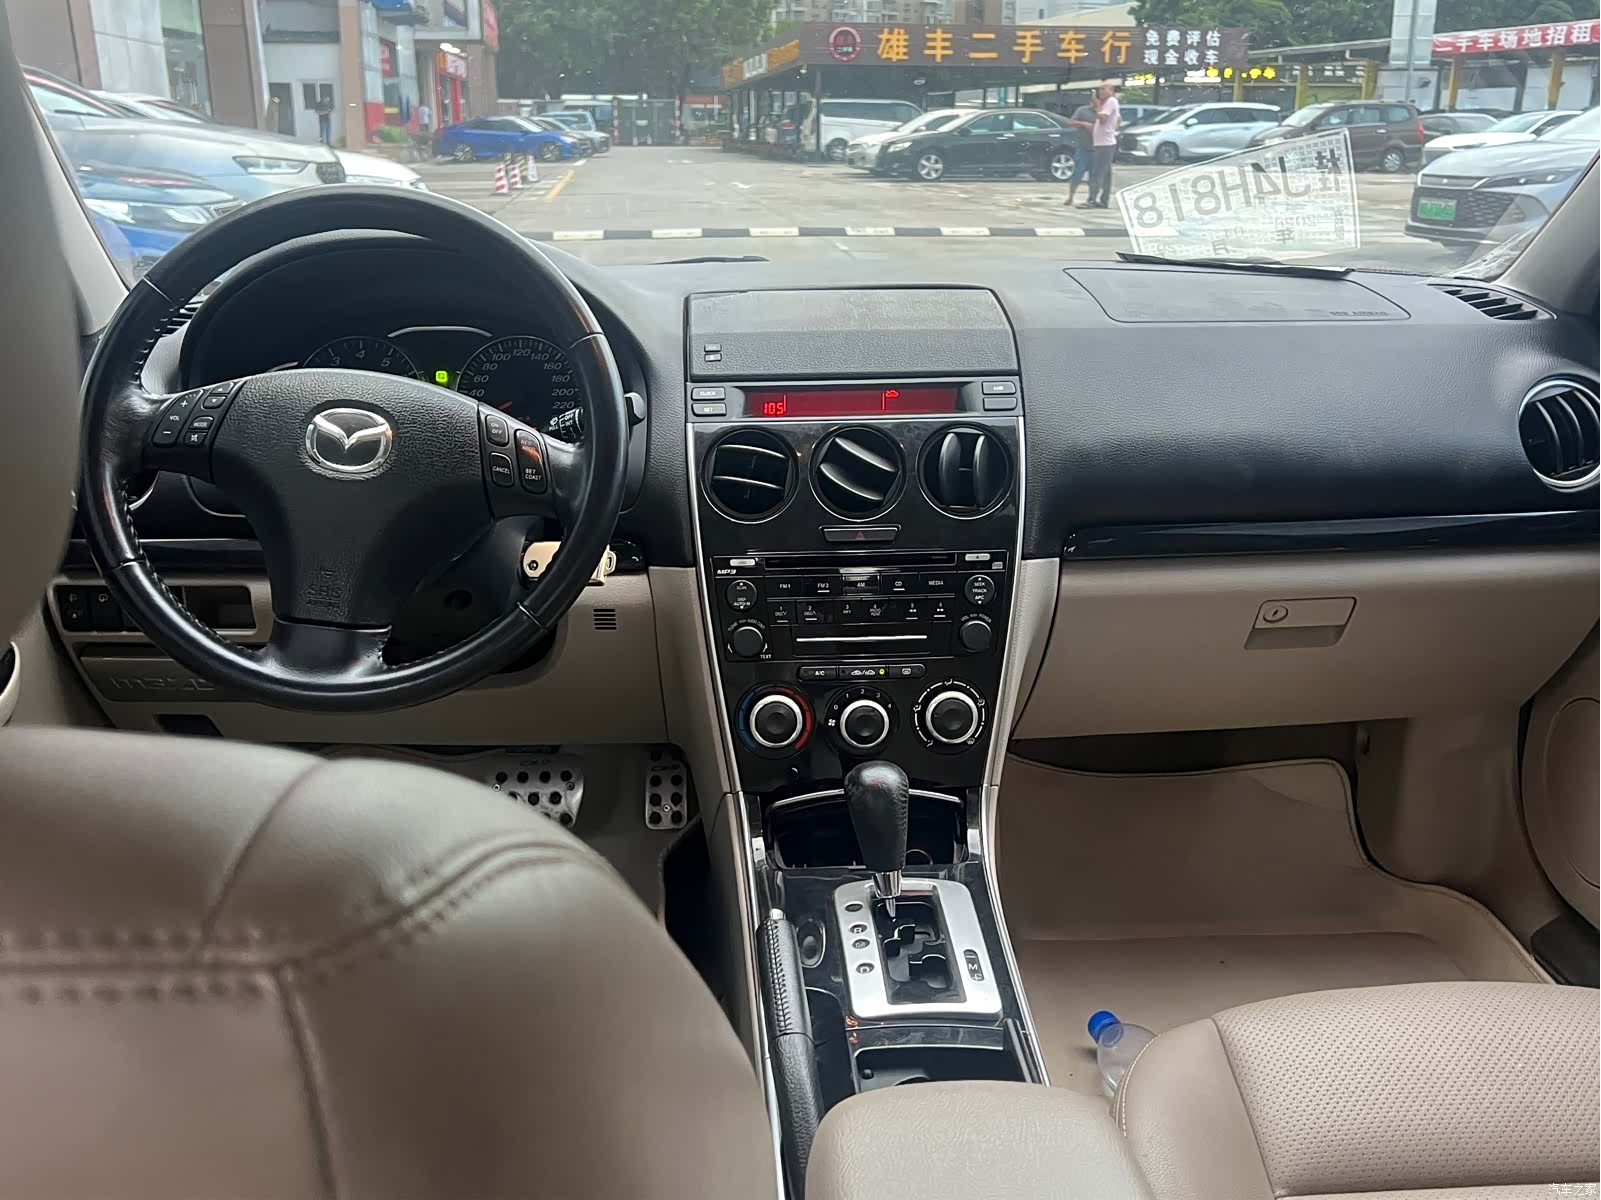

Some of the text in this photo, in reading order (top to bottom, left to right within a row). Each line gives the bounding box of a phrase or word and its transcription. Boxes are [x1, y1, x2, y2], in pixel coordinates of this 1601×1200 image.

[1144, 29, 1222, 48] 免费评估
[1432, 24, 1592, 53] 二手车场地招租
[876, 27, 1133, 65] 雄丰二手车行
[1142, 48, 1221, 66] 现金收车
[355, 349, 367, 359] 4
[492, 352, 512, 361] 100
[512, 348, 531, 357] 120
[530, 352, 550, 361] 140
[330, 355, 342, 367] 3
[379, 358, 393, 368] 5
[481, 362, 498, 371] 80
[543, 362, 563, 370] 160
[473, 374, 490, 383] 60
[551, 374, 571, 383] 180
[468, 389, 485, 397] 40
[551, 388, 575, 396] 200
[552, 401, 575, 409] 220
[492, 465, 511, 475] CANCEL
